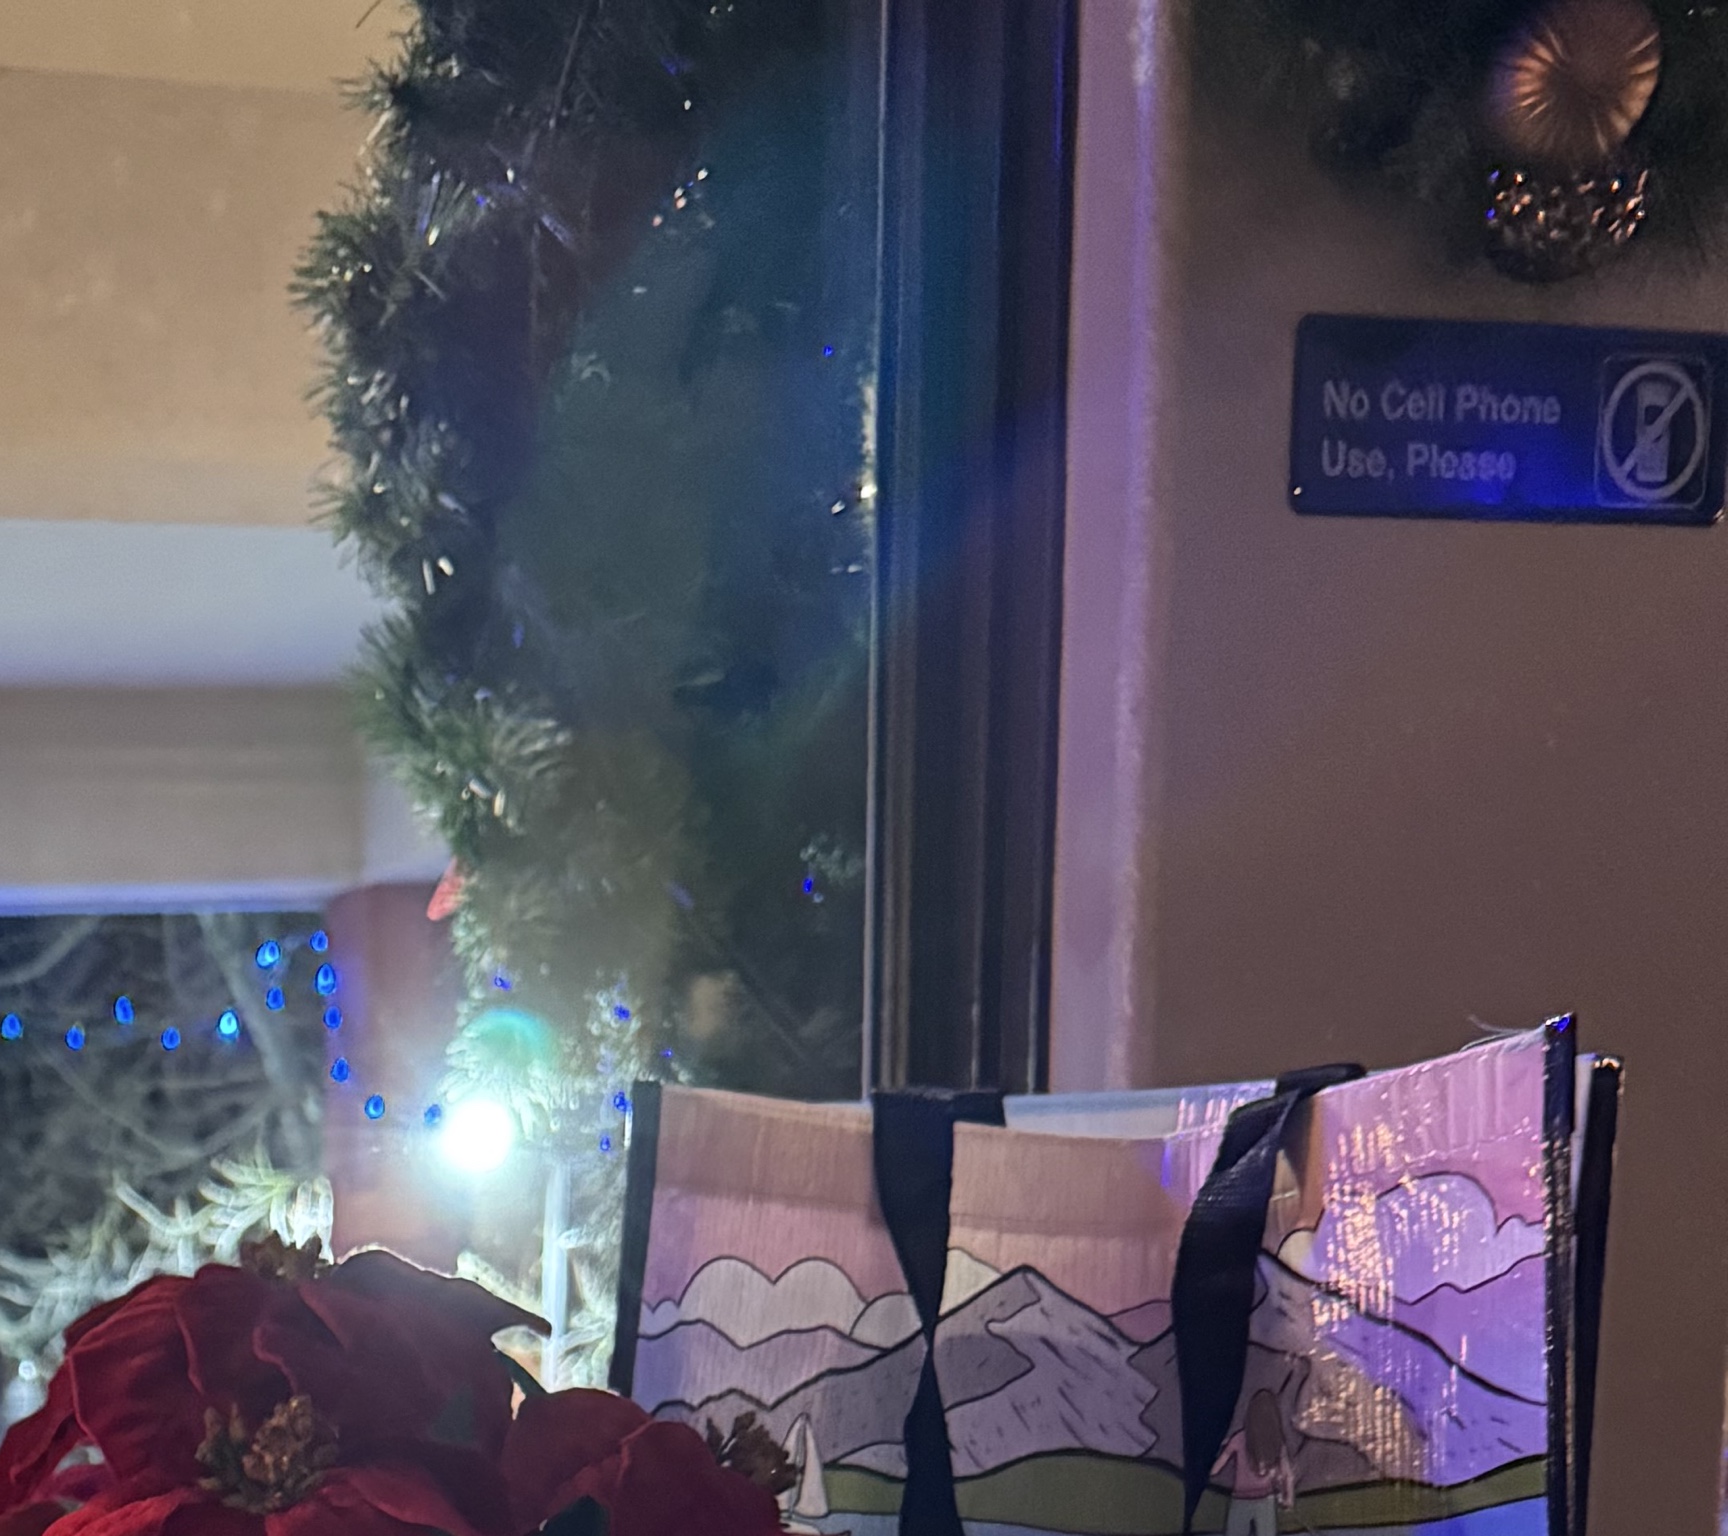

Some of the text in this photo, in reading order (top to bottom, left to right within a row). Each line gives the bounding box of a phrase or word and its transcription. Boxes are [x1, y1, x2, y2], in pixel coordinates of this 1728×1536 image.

[1322, 380, 1562, 425] No Cell Phone
[1321, 438, 1517, 482] Use, Please
